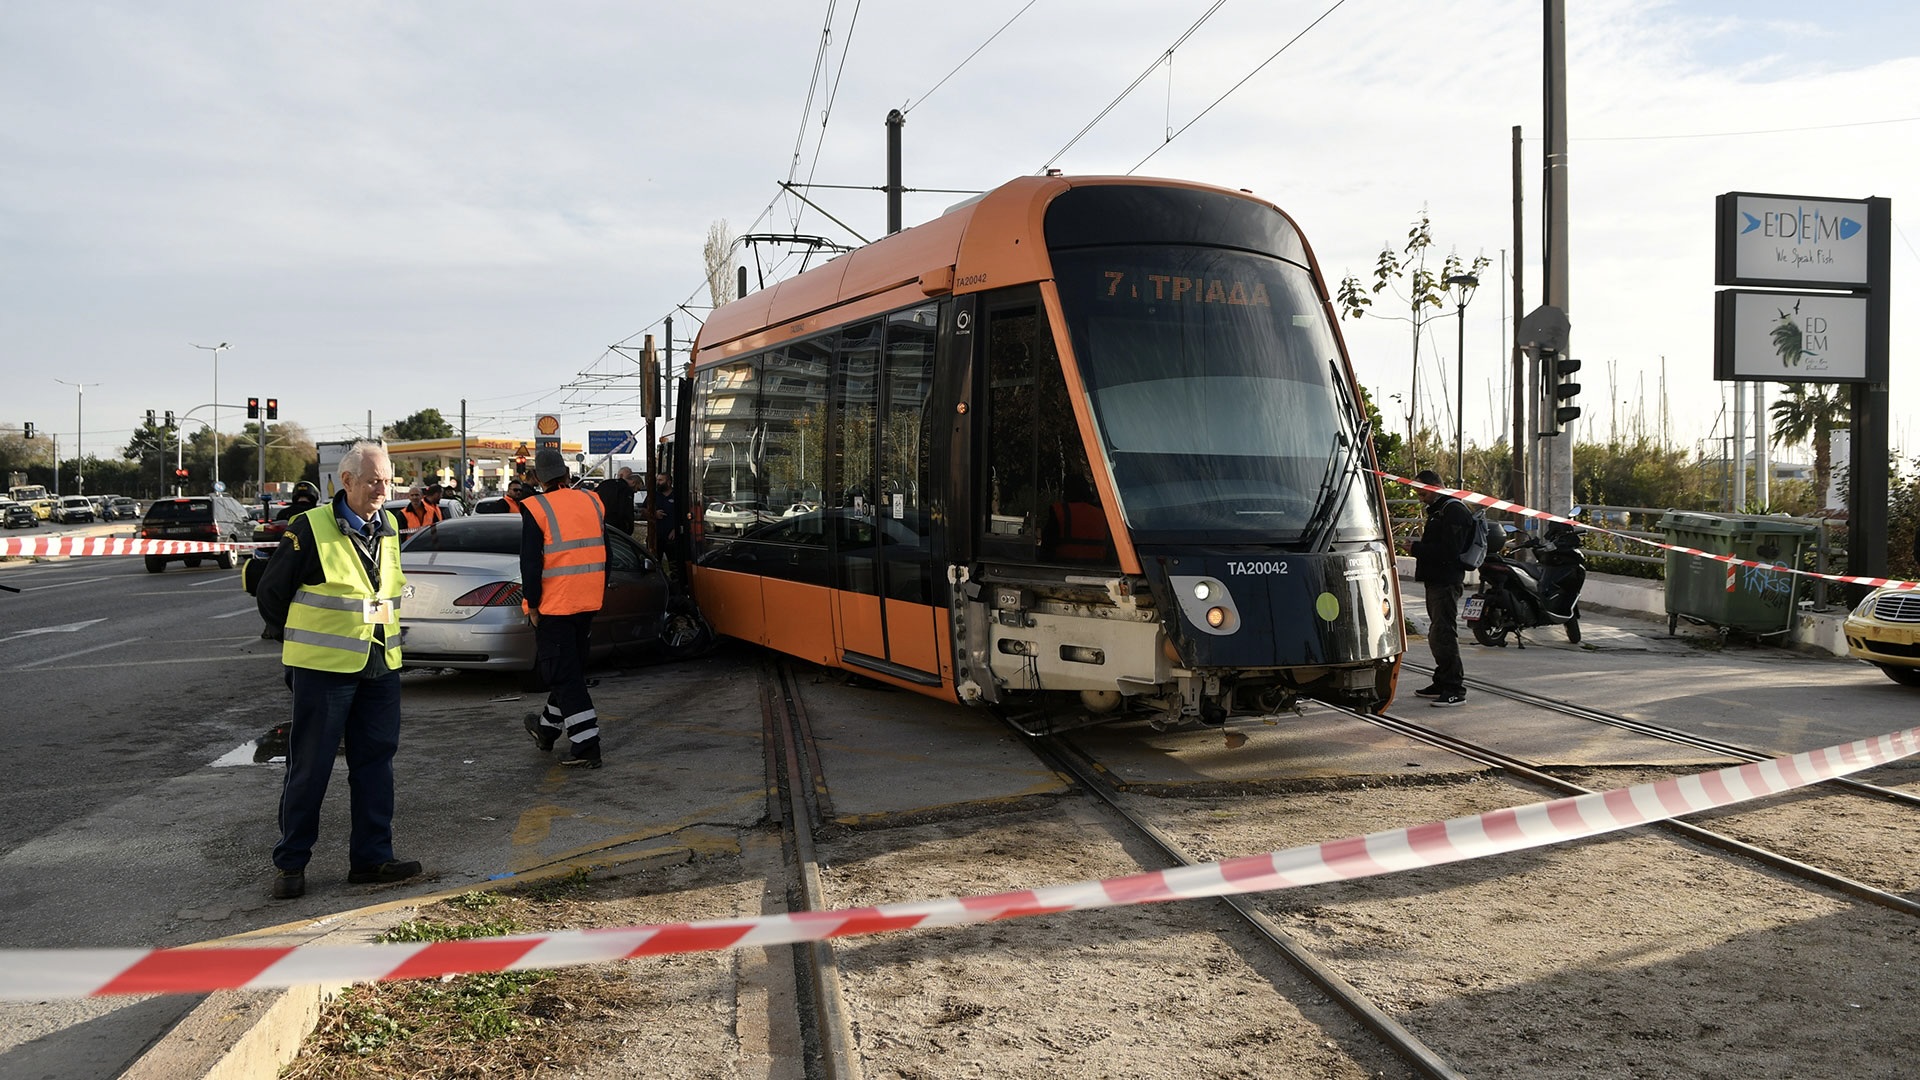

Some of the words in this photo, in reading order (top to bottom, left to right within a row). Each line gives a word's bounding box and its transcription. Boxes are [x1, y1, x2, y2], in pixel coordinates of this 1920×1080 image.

[1775, 247, 1788, 263] We
[1791, 248, 1814, 268] Speak
[1817, 249, 1834, 264] Fish
[956, 273, 987, 288] TA20042
[1104, 271, 1124, 296] 7
[1148, 274, 1271, 307] ΤΡΙΑΔΑ
[1805, 317, 1828, 334] ED
[1805, 334, 1828, 351] EM
[485, 441, 513, 450] Shell
[1226, 561, 1289, 576] TA20042
